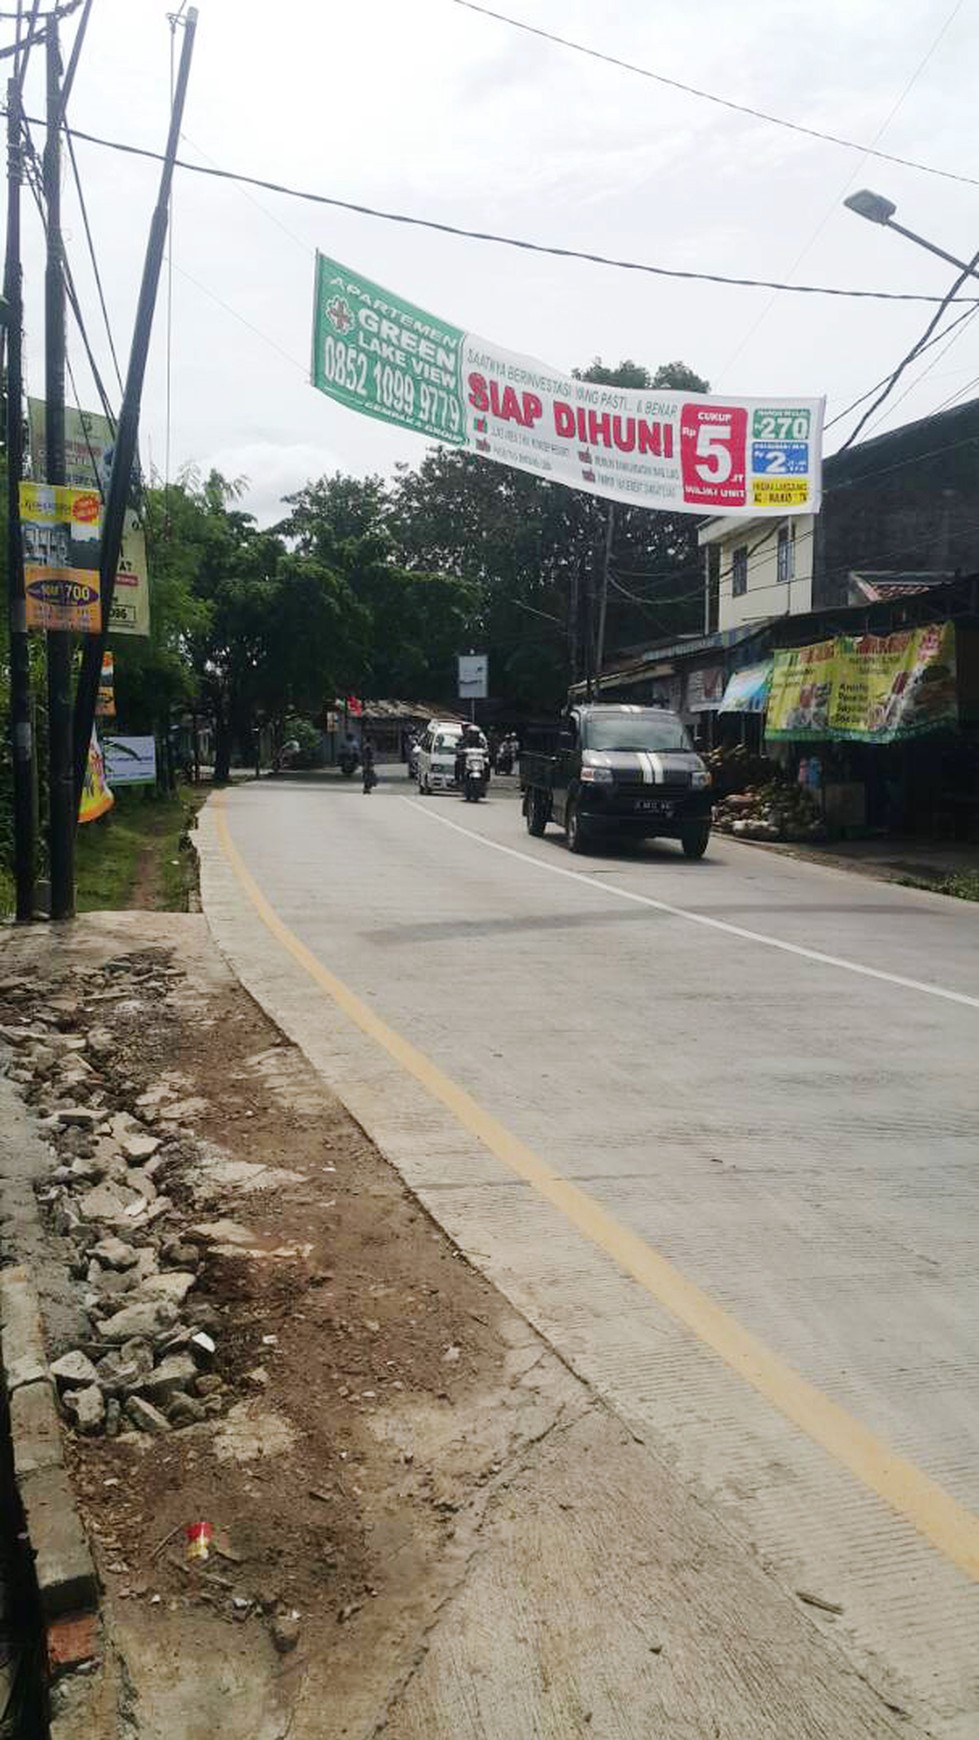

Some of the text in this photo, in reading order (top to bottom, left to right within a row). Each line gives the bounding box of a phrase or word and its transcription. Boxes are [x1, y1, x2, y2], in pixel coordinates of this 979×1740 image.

[329, 276, 458, 350] APARTEMEN
[358, 307, 456, 371] GREEN
[324, 335, 460, 433] 0852 1099 9779
[357, 331, 457, 389] LAKE VIEW
[467, 348, 507, 378] SAATNYA
[507, 366, 573, 398] BERINVESTASI
[574, 385, 598, 405] YANG
[467, 372, 543, 429] SIAP
[553, 399, 674, 459] DIHUNI
[682, 427, 697, 439] Rp
[697, 411, 732, 423] CUKUP
[760, 417, 810, 438] 270
[695, 424, 733, 484] 5
[765, 451, 787, 473] 2
[65, 584, 90, 601] 700
